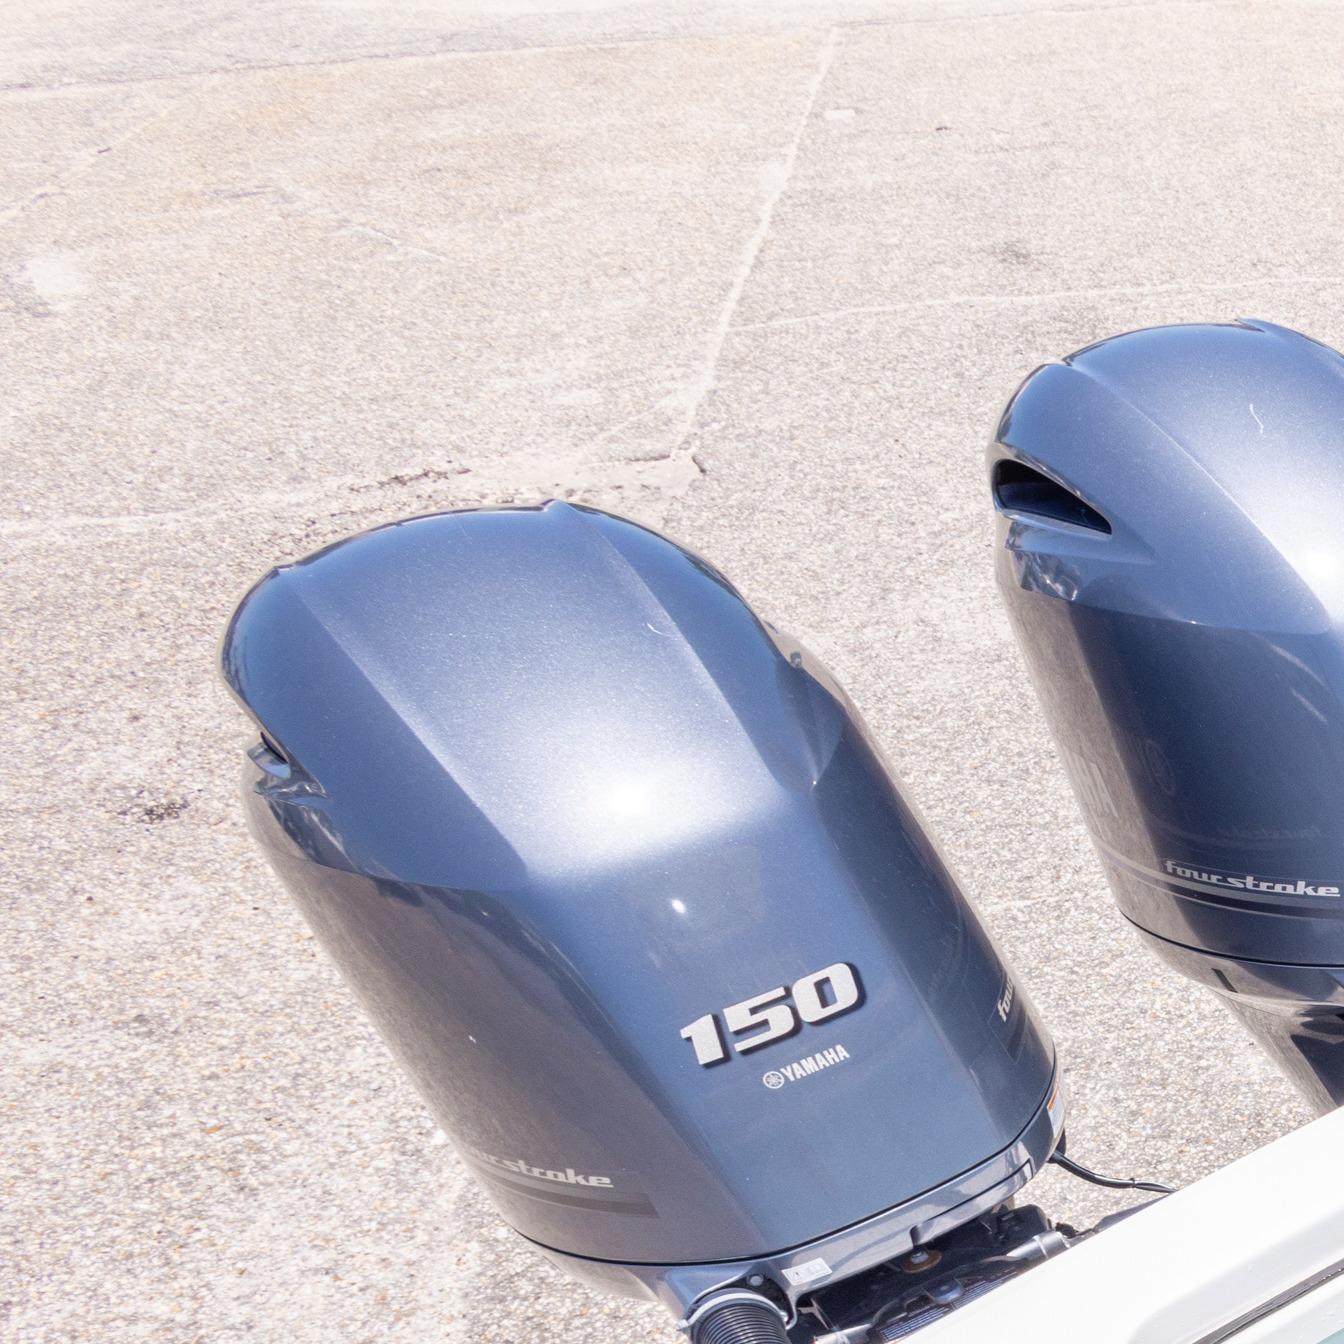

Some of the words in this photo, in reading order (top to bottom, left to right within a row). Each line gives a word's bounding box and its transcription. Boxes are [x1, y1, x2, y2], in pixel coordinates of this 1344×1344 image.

[1165, 860, 1223, 885] four
[1224, 876, 1341, 897] stroke
[680, 962, 862, 1067] 150
[780, 1044, 851, 1082] YAMAHA
[500, 1159, 615, 1188] stroke
